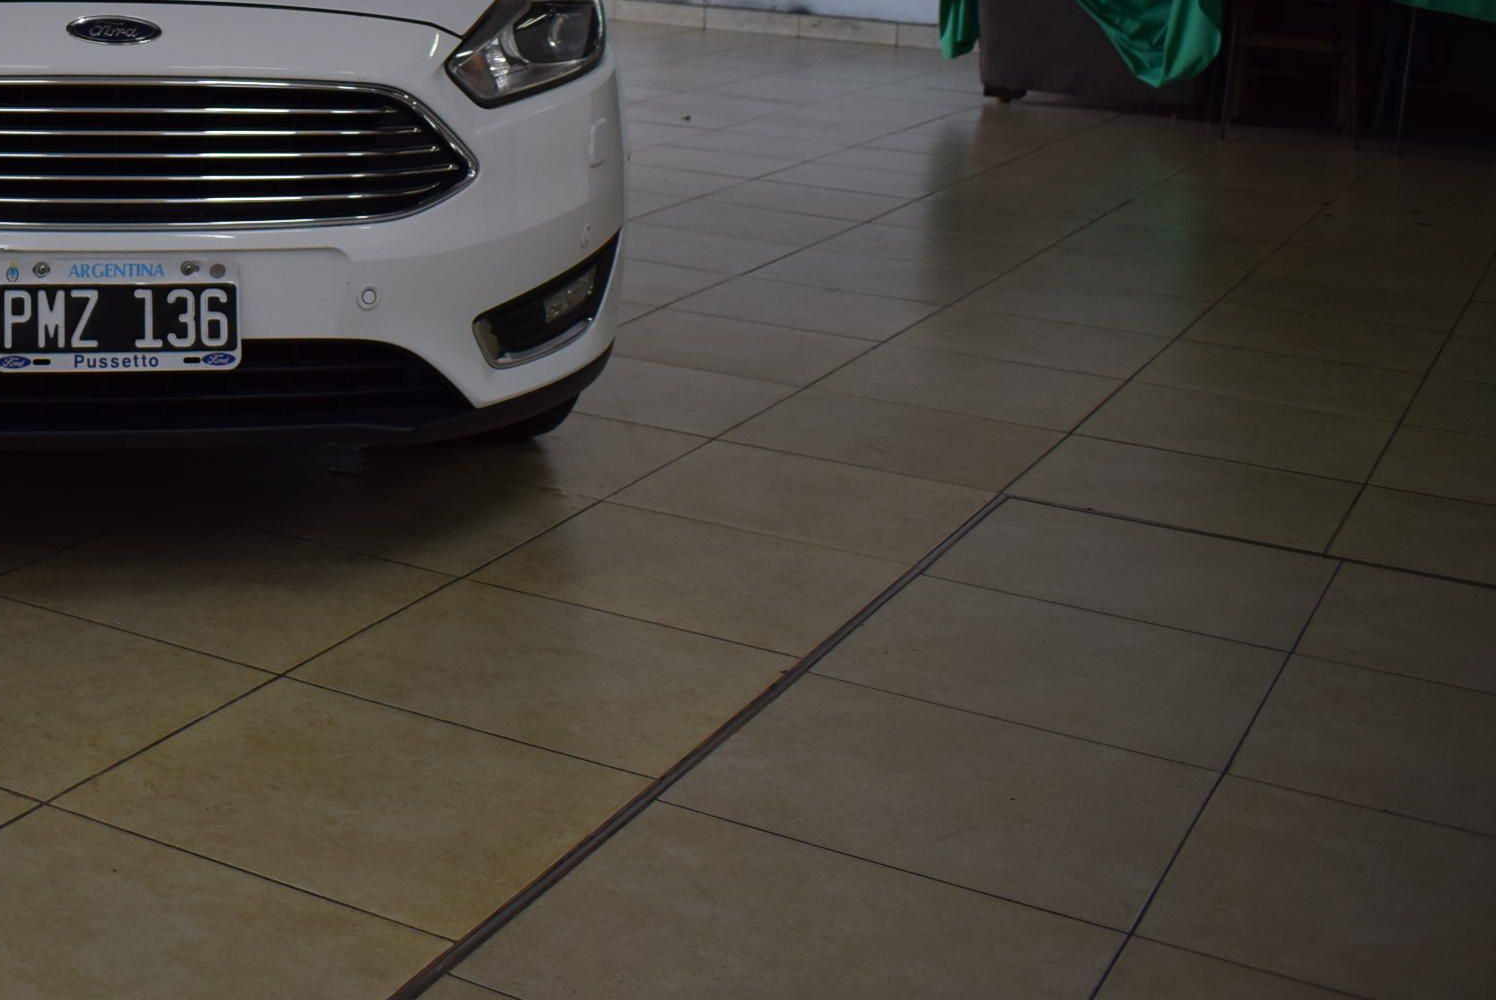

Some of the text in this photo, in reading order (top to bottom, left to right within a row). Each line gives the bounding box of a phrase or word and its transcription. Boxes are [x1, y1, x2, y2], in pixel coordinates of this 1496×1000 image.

[68, 263, 166, 279] ARGENTINA
[4, 288, 229, 349] PMZ 136
[73, 354, 160, 368] Pussetto
